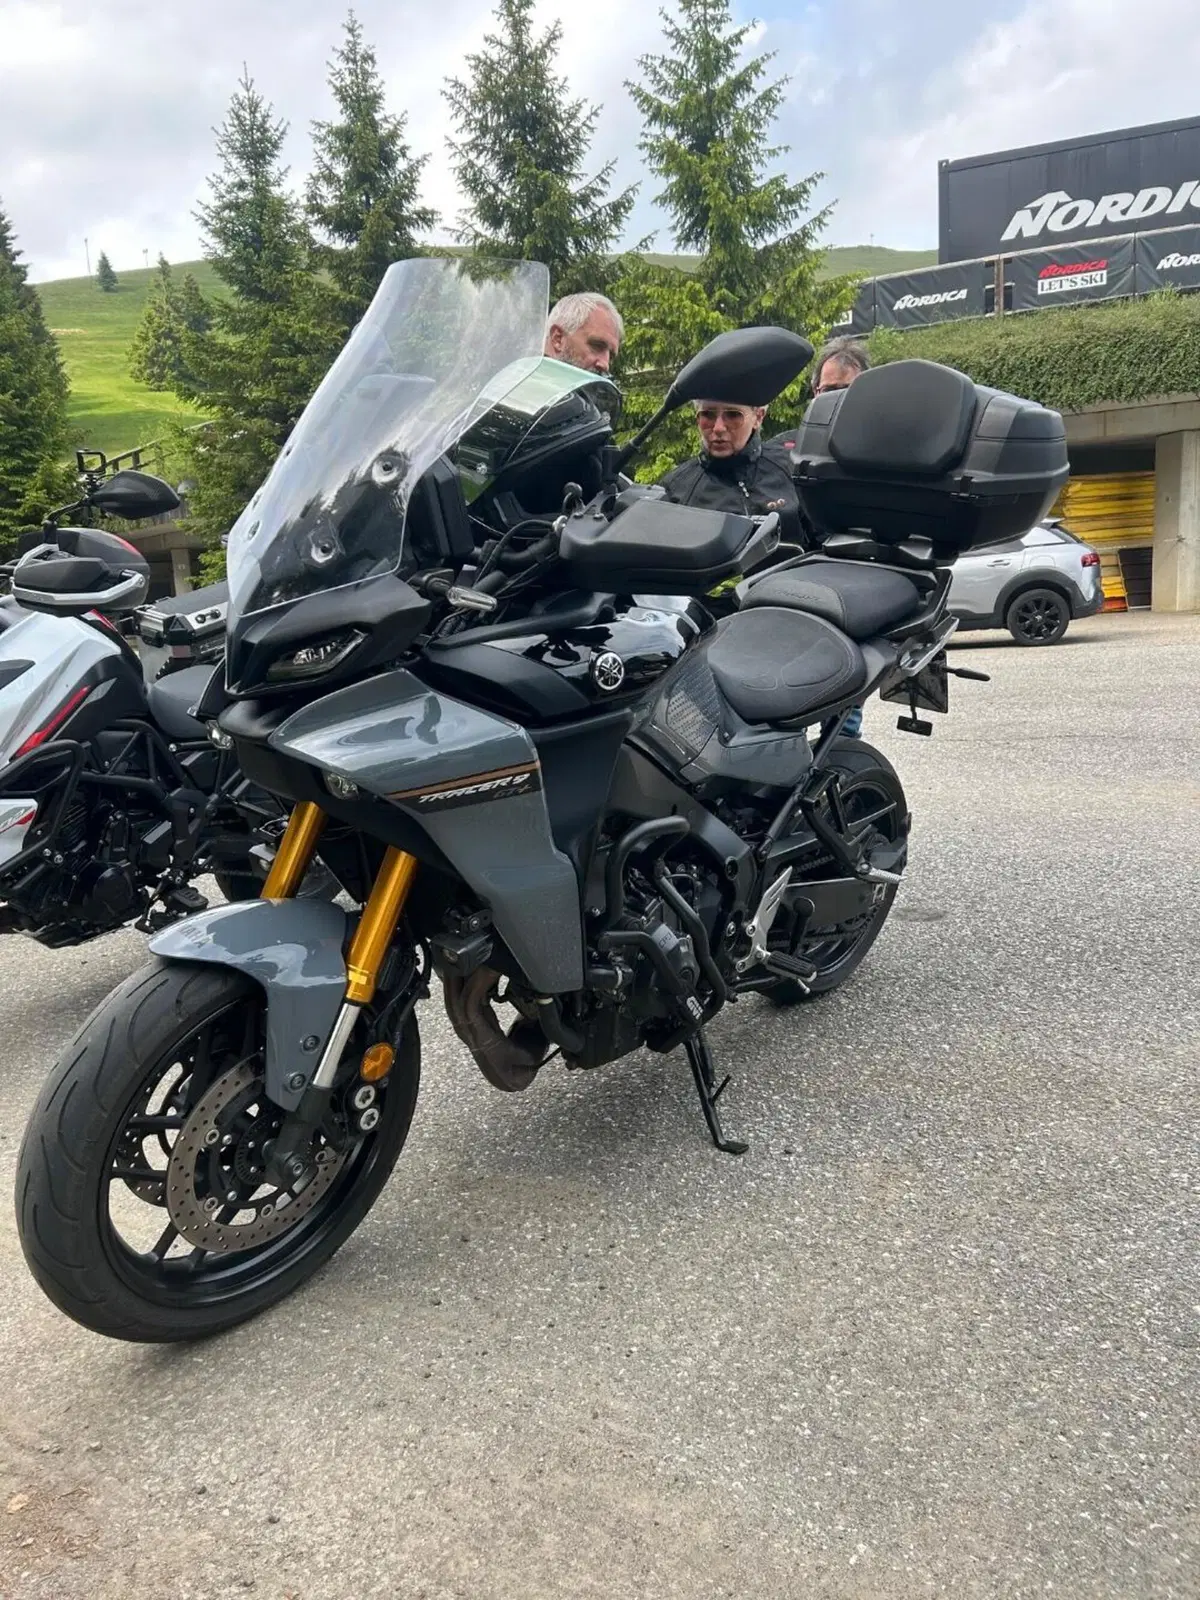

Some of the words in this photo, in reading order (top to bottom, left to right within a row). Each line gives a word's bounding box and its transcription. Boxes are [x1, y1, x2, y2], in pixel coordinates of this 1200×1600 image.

[1039, 259, 1108, 278] NORDICA
[1040, 276, 1078, 292] LET'S
[1081, 272, 1105, 287] SKI
[892, 288, 968, 311] NORDICA
